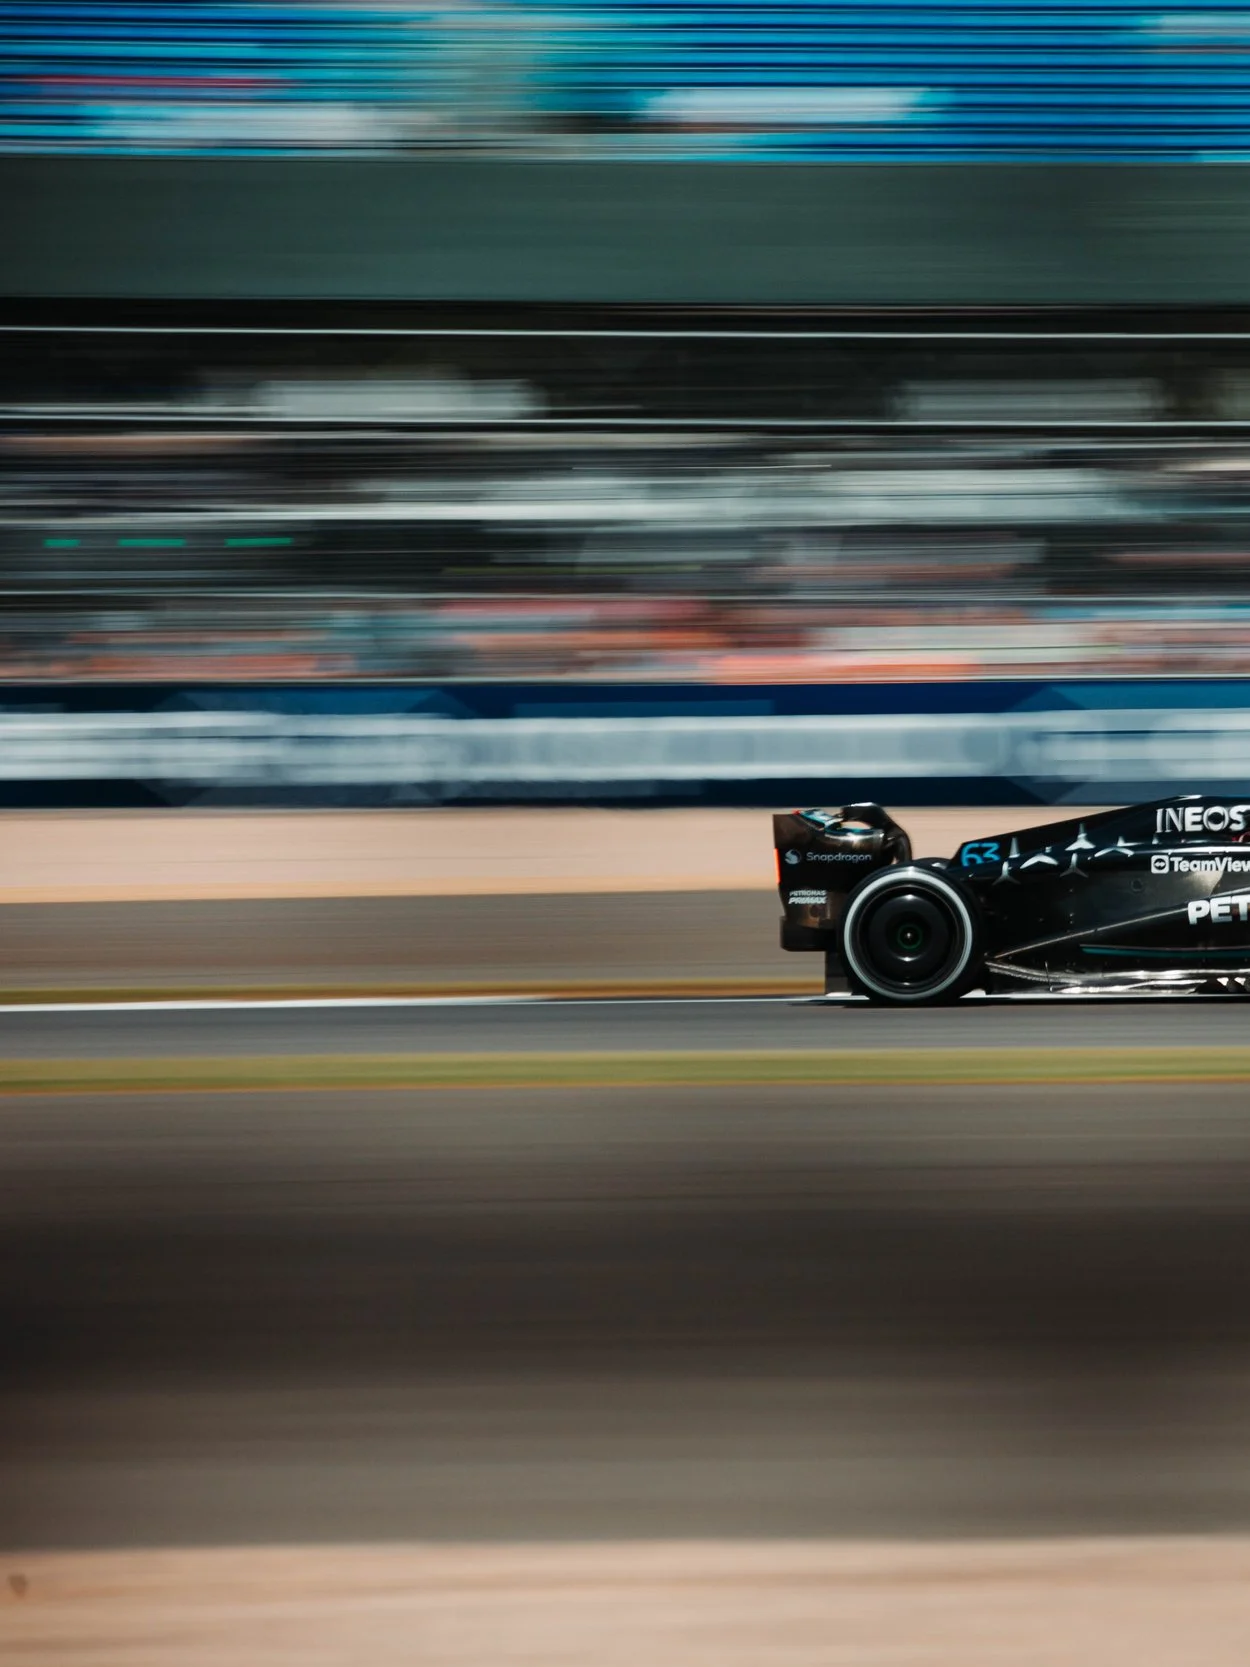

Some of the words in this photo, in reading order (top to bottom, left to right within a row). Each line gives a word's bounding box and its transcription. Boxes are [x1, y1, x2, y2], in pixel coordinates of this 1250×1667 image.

[1156, 806, 1246, 833] INEOS
[806, 852, 872, 863] Snapdragon
[961, 842, 1001, 867] 63
